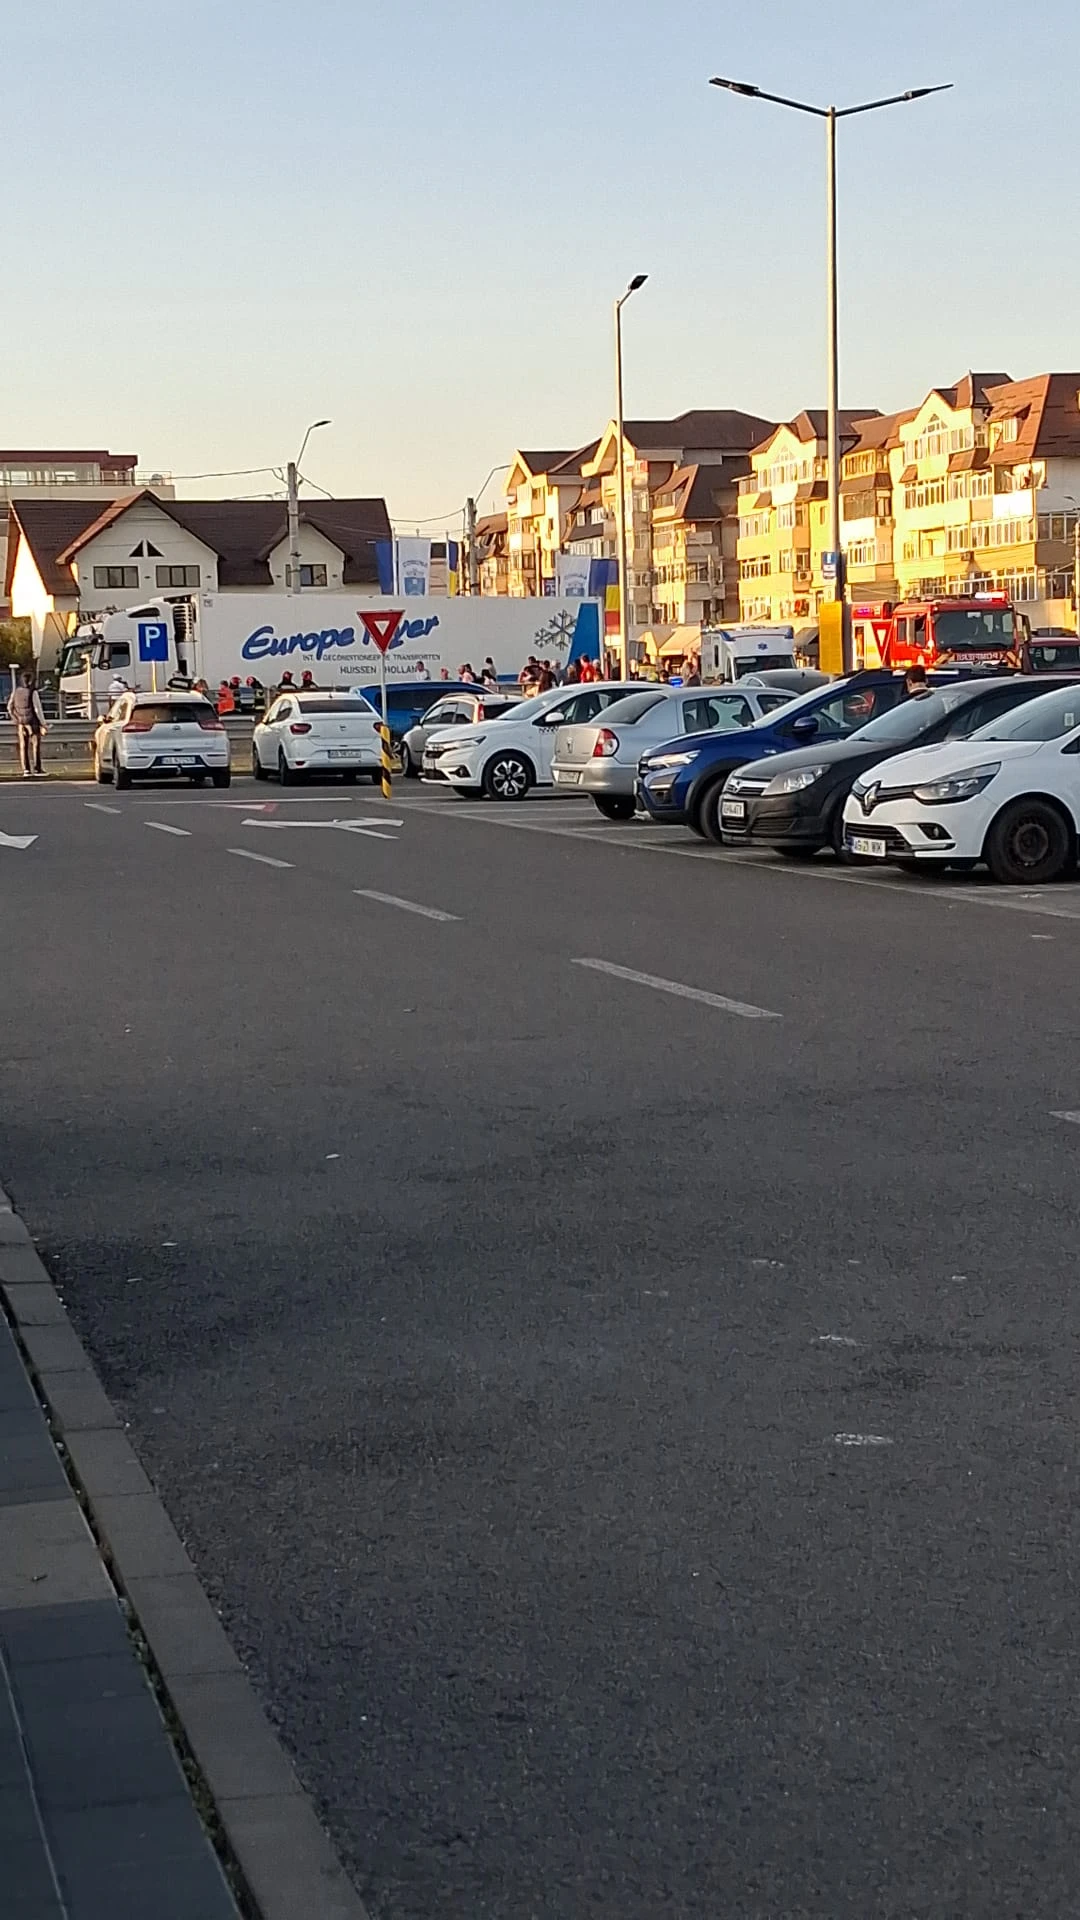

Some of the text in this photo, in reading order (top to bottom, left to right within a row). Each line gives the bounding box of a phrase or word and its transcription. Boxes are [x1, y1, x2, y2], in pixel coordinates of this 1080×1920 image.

[145, 626, 160, 648] P
[242, 626, 355, 660] Europe
[340, 665, 417, 674] HUISSEN HOLLAN
